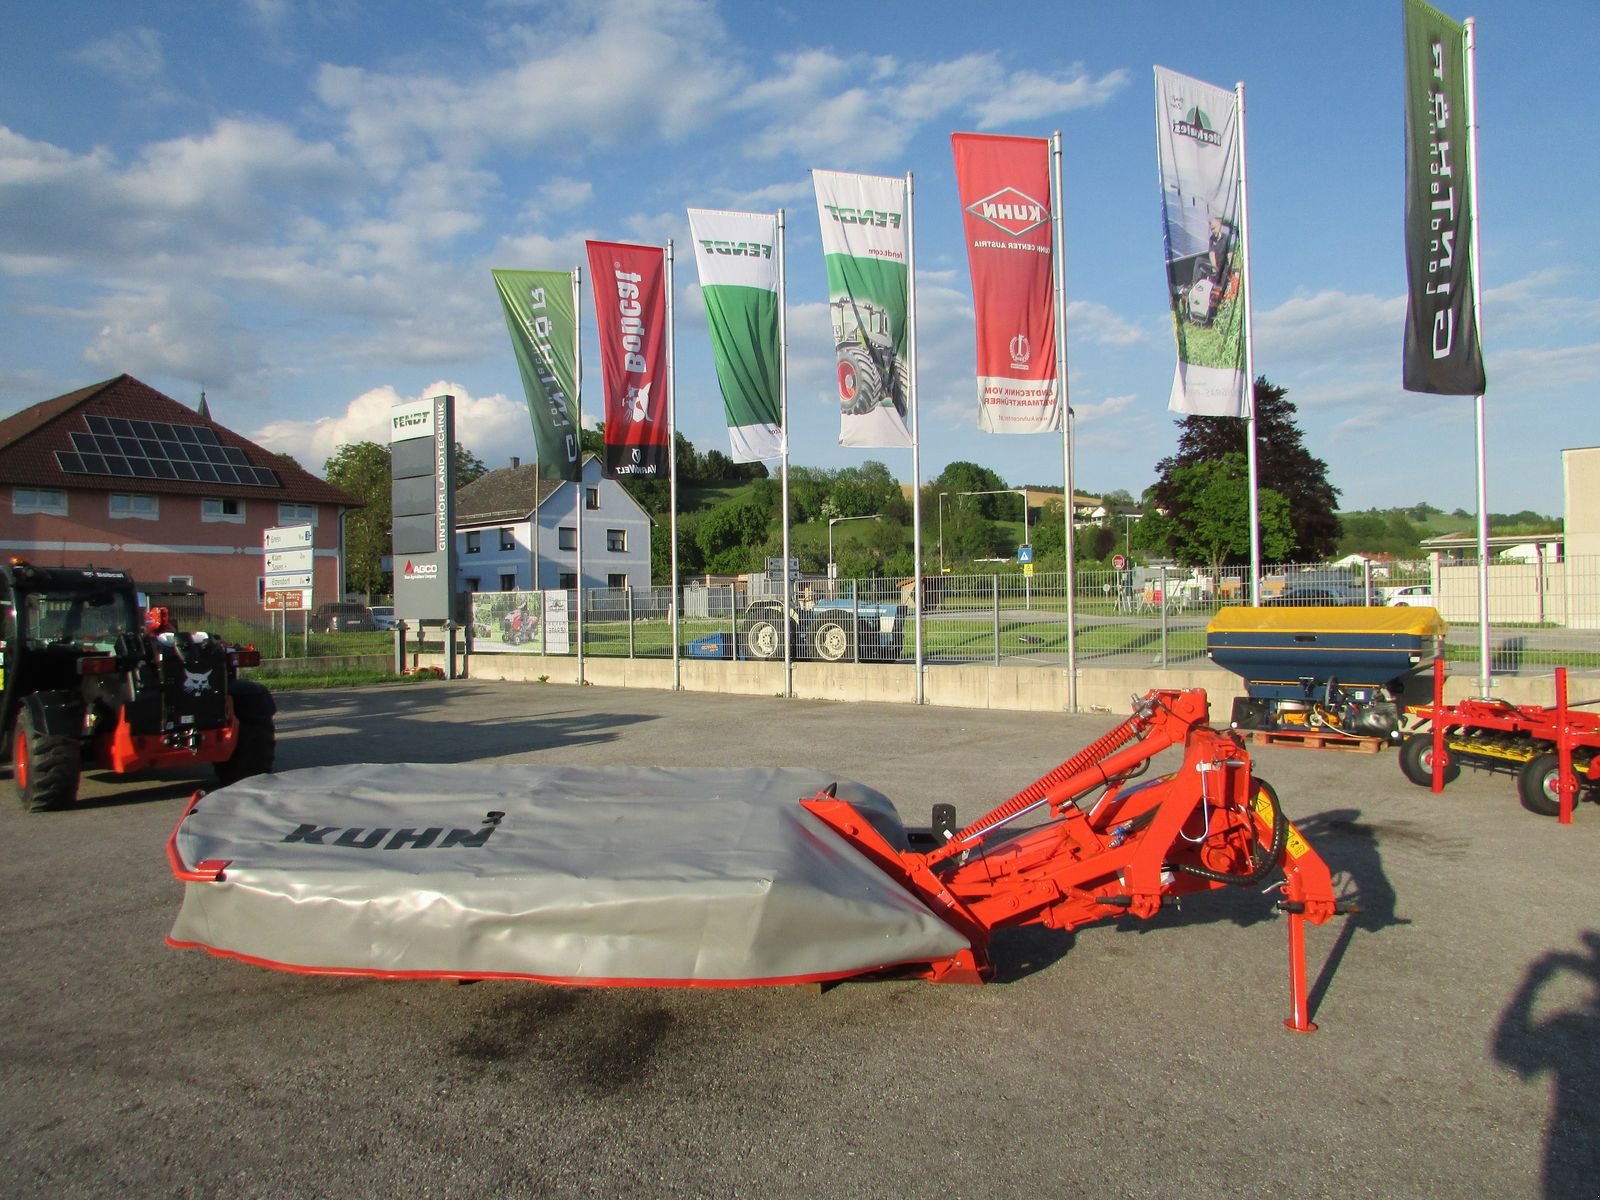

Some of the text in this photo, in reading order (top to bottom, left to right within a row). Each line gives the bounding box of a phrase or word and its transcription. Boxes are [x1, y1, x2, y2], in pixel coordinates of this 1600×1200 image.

[393, 411, 430, 429] FENDT
[437, 402, 446, 551] GINTHÖR LANDTECHNIK
[413, 564, 438, 573] AGCO
[280, 823, 498, 850] KUHN
